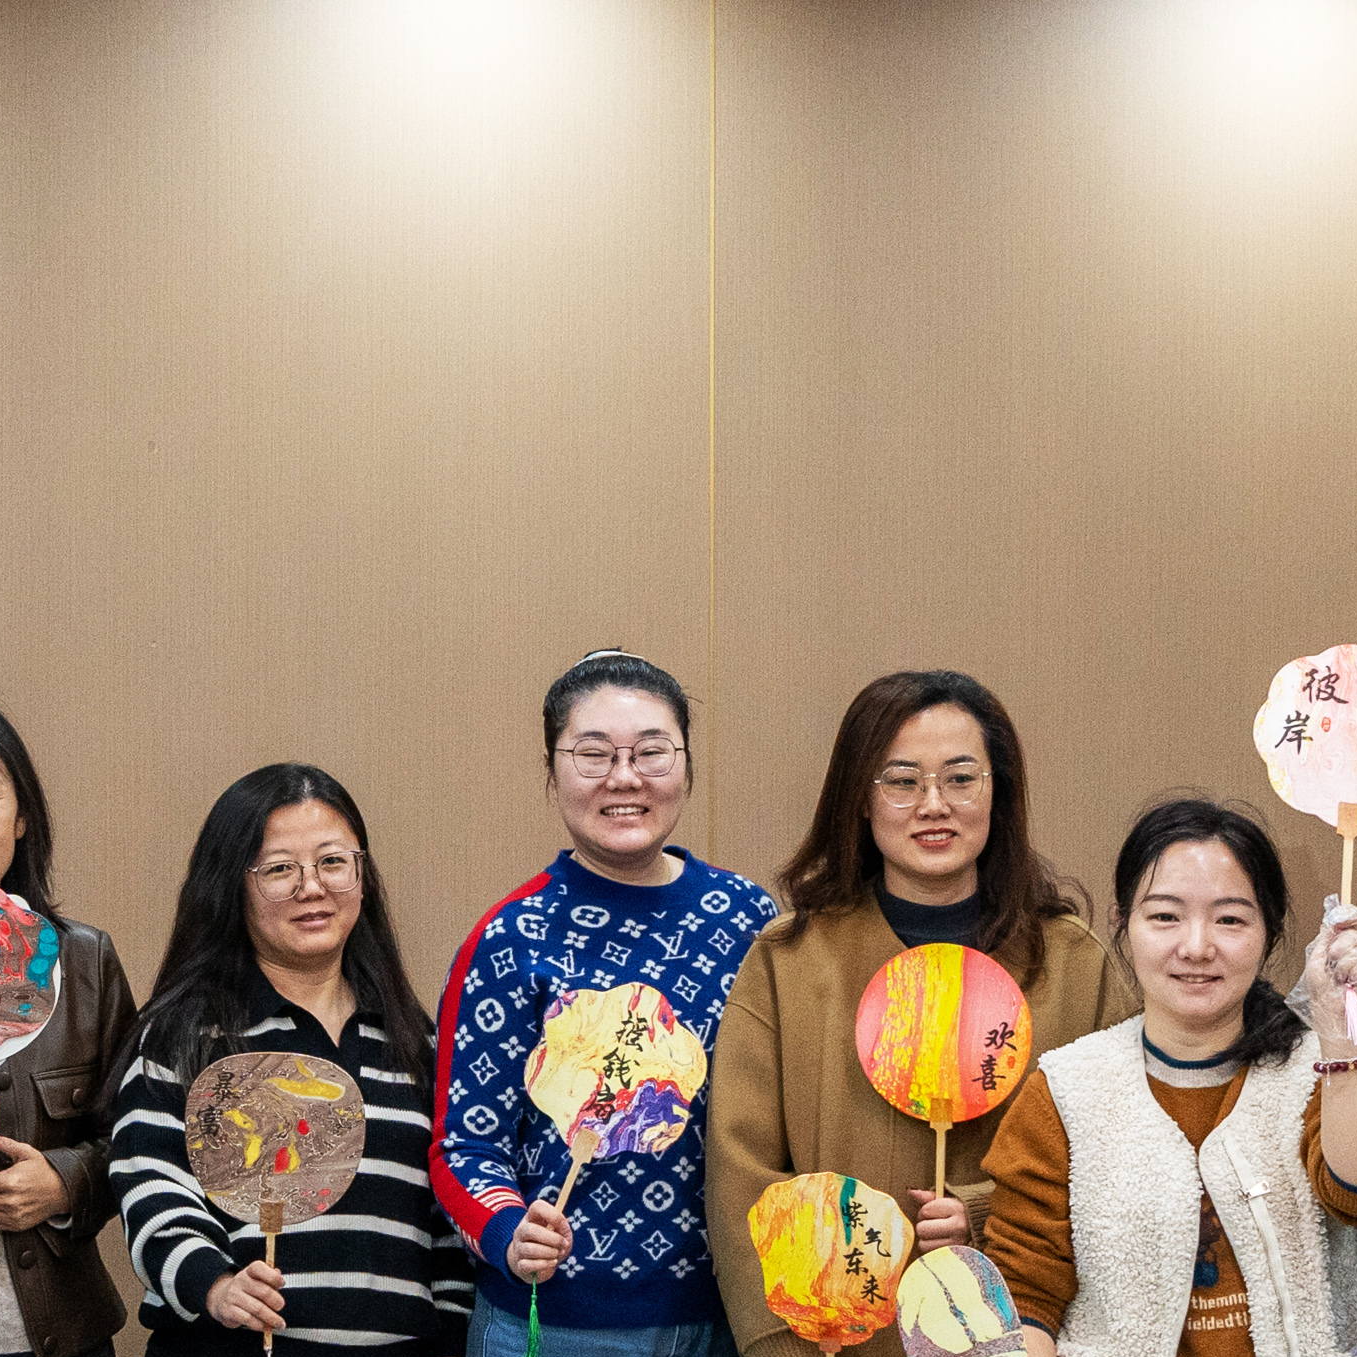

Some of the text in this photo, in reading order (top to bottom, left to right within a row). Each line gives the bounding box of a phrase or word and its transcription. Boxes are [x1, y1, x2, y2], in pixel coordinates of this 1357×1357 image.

[1274, 665, 1350, 754] 彼岸
[972, 1020, 1017, 1092] 欢喜
[197, 1071, 240, 1137] 暴富
[842, 1201, 892, 1306] 紫气东来
